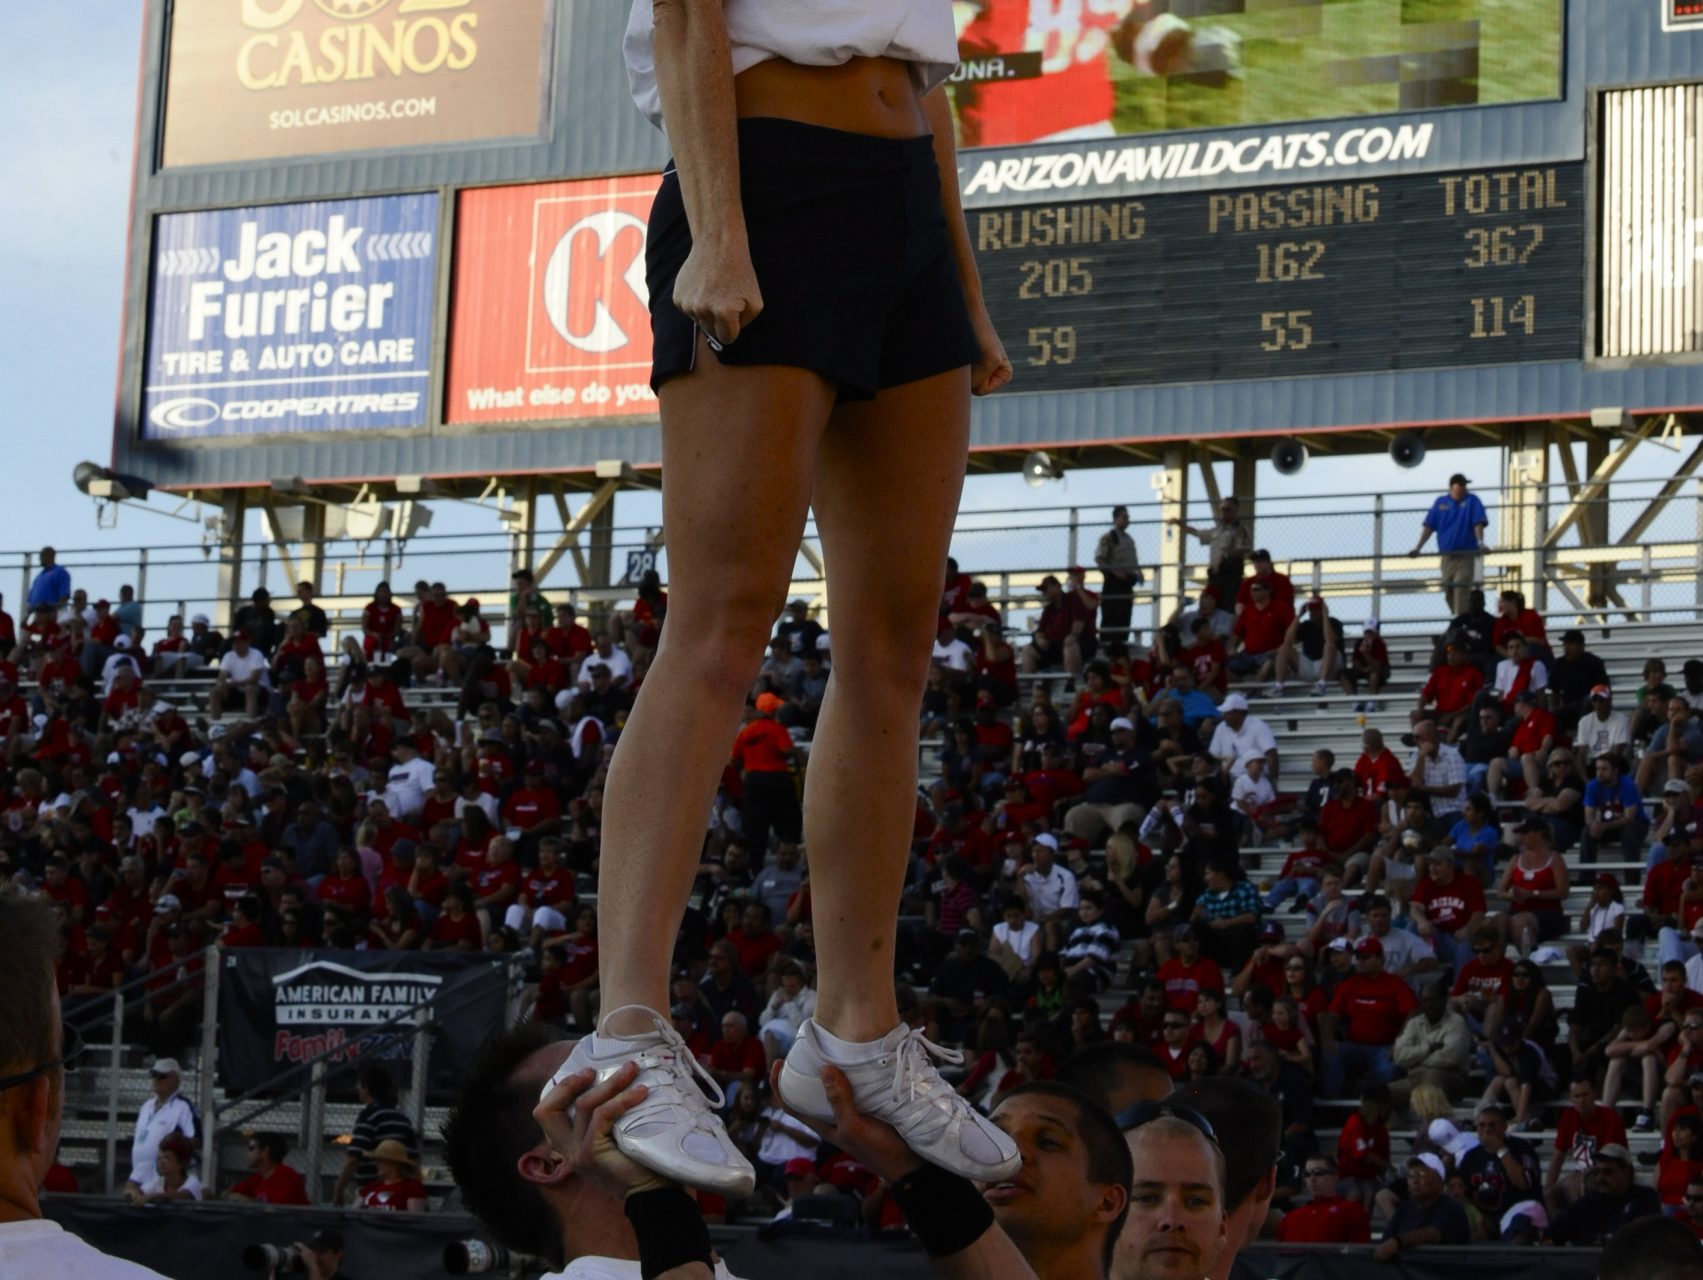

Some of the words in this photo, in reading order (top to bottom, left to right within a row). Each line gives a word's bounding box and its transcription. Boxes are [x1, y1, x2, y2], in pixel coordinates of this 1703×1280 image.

[236, 13, 478, 90] CASINOS
[949, 57, 1016, 82] ONA.
[269, 97, 436, 129] SOLCASINOS.COM
[963, 123, 1434, 195] ARIZONAWILDCATS.COM
[978, 202, 1146, 251] RUSHING
[1209, 184, 1380, 233] PASSING
[1438, 170, 1567, 216] TOTAL
[223, 215, 363, 282] Jack
[1019, 256, 1094, 299] 205
[1256, 240, 1325, 283] 162
[1464, 224, 1544, 268] 367
[188, 281, 394, 341] Furrier
[1028, 326, 1077, 366] 59
[1261, 310, 1313, 352] 55
[1470, 295, 1535, 338] 114
[162, 350, 224, 376] TIRE
[230, 349, 250, 372] &
[258, 342, 334, 370] AUTO
[340, 338, 415, 365] CARE
[467, 386, 524, 410] What
[529, 384, 576, 406] else
[581, 381, 611, 404] do
[275, 984, 365, 1004] AMERICAN
[371, 984, 437, 1005] FAMILY
